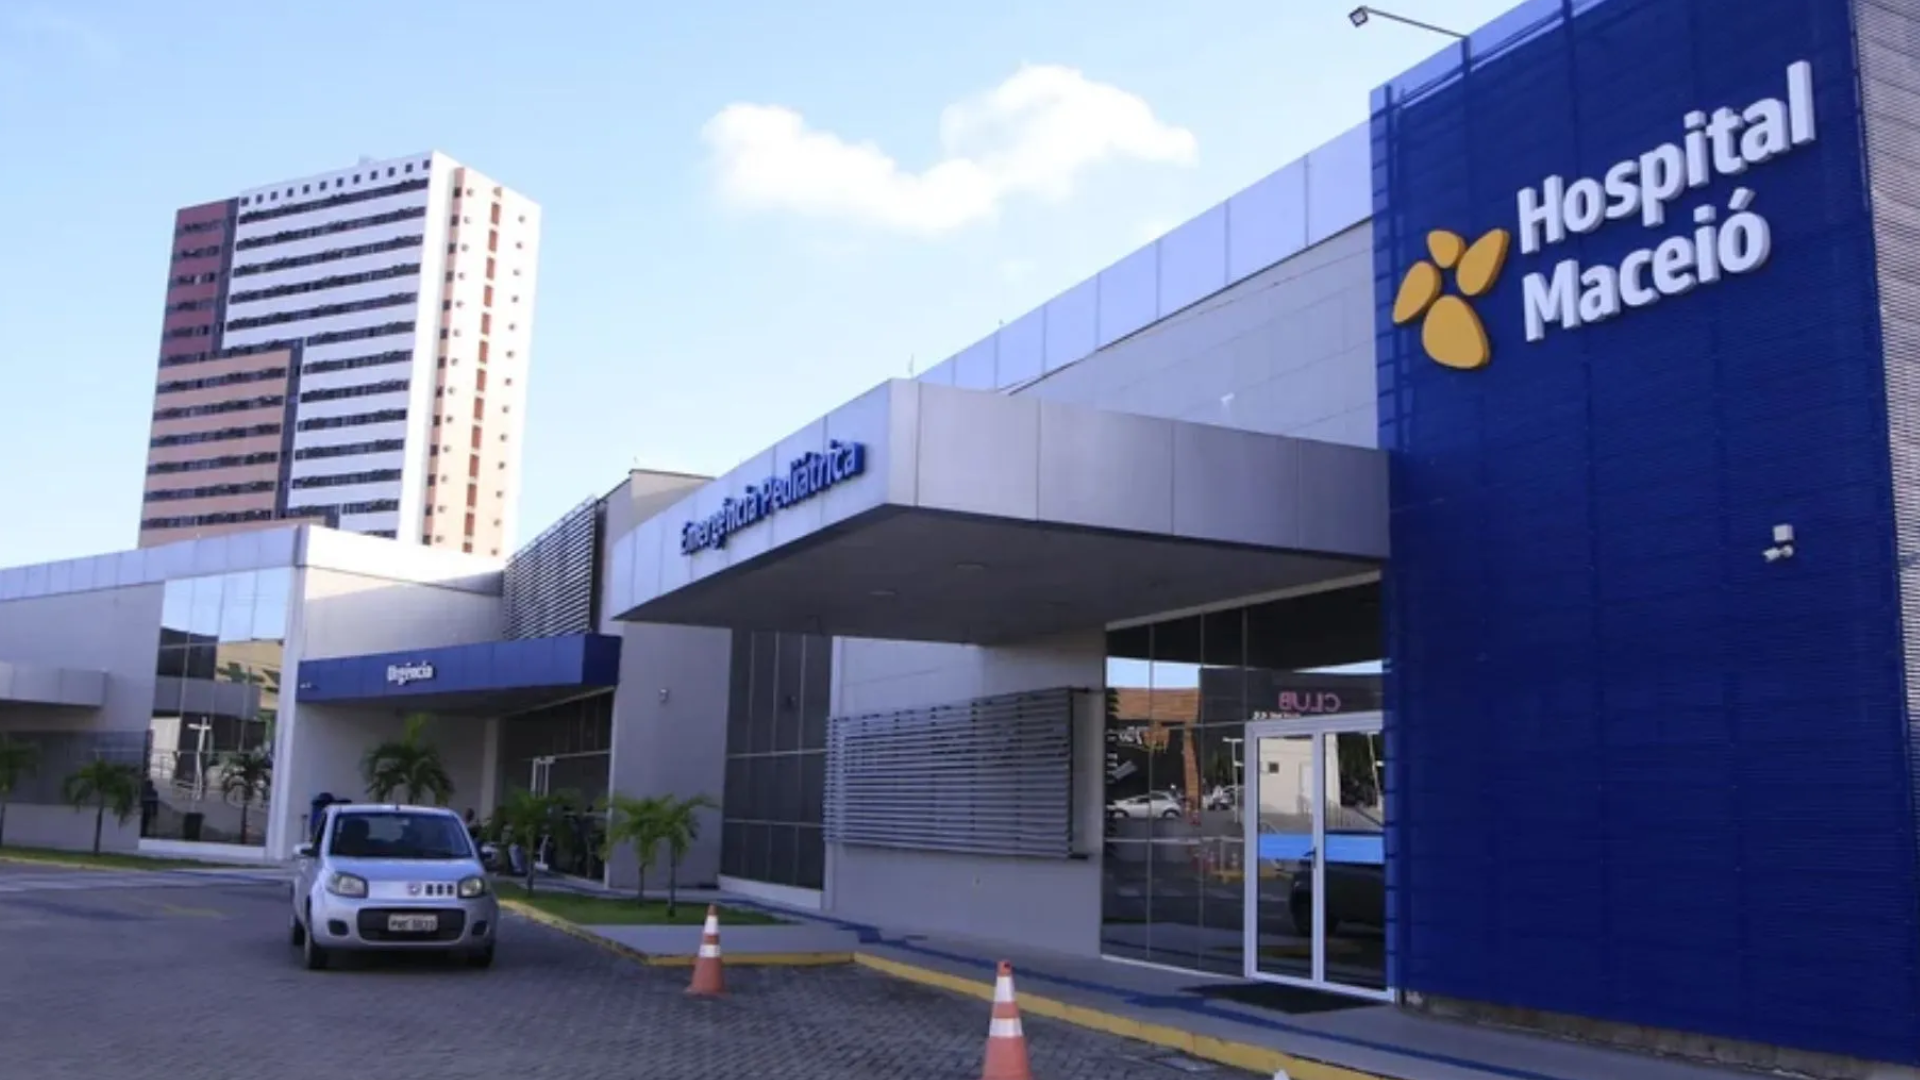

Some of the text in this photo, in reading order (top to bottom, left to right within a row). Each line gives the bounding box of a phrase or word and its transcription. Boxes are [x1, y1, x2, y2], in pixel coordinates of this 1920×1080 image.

[1517, 60, 1816, 254] Hospital
[1522, 188, 1771, 342] Maceió
[681, 439, 866, 555] Emergência Pediátrica
